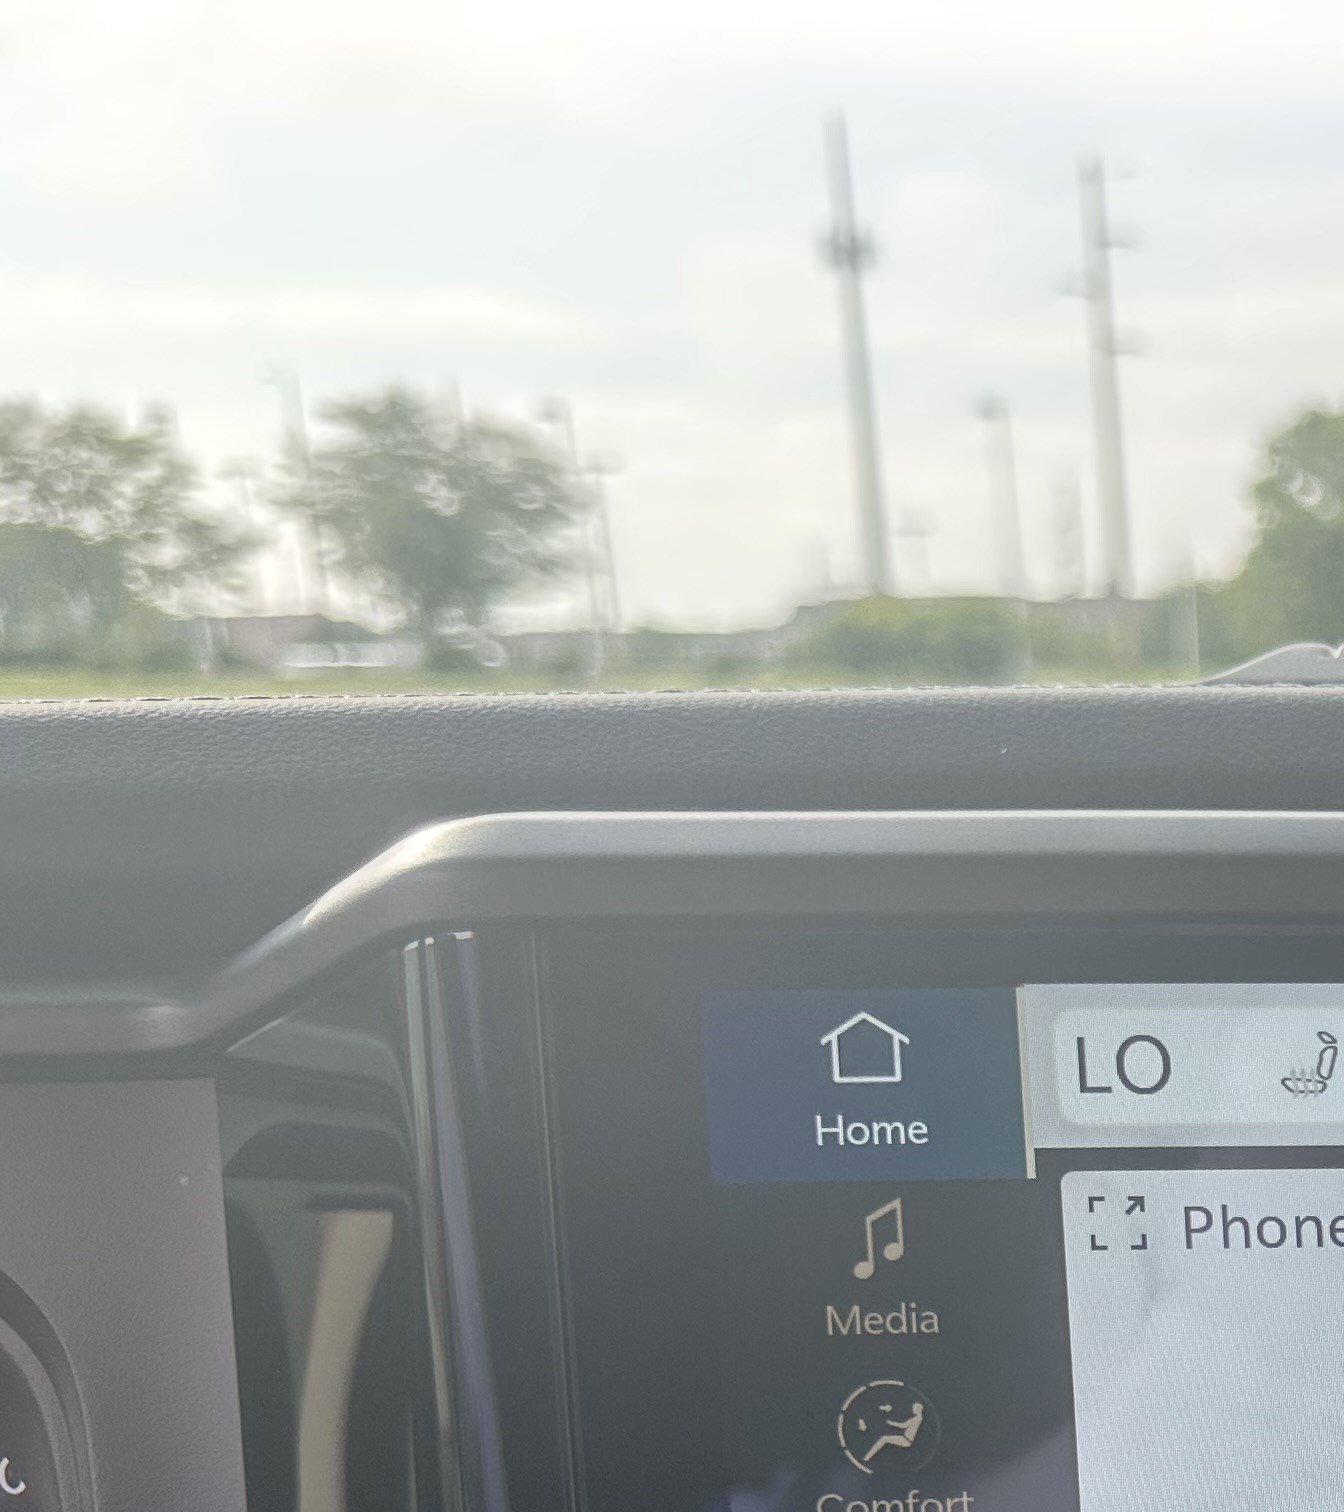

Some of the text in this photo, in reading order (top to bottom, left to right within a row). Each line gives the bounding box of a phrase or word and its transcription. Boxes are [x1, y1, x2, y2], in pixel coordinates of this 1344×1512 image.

[1076, 1034, 1172, 1096] LO
[814, 1113, 930, 1147] Home
[825, 1302, 941, 1337] Media
